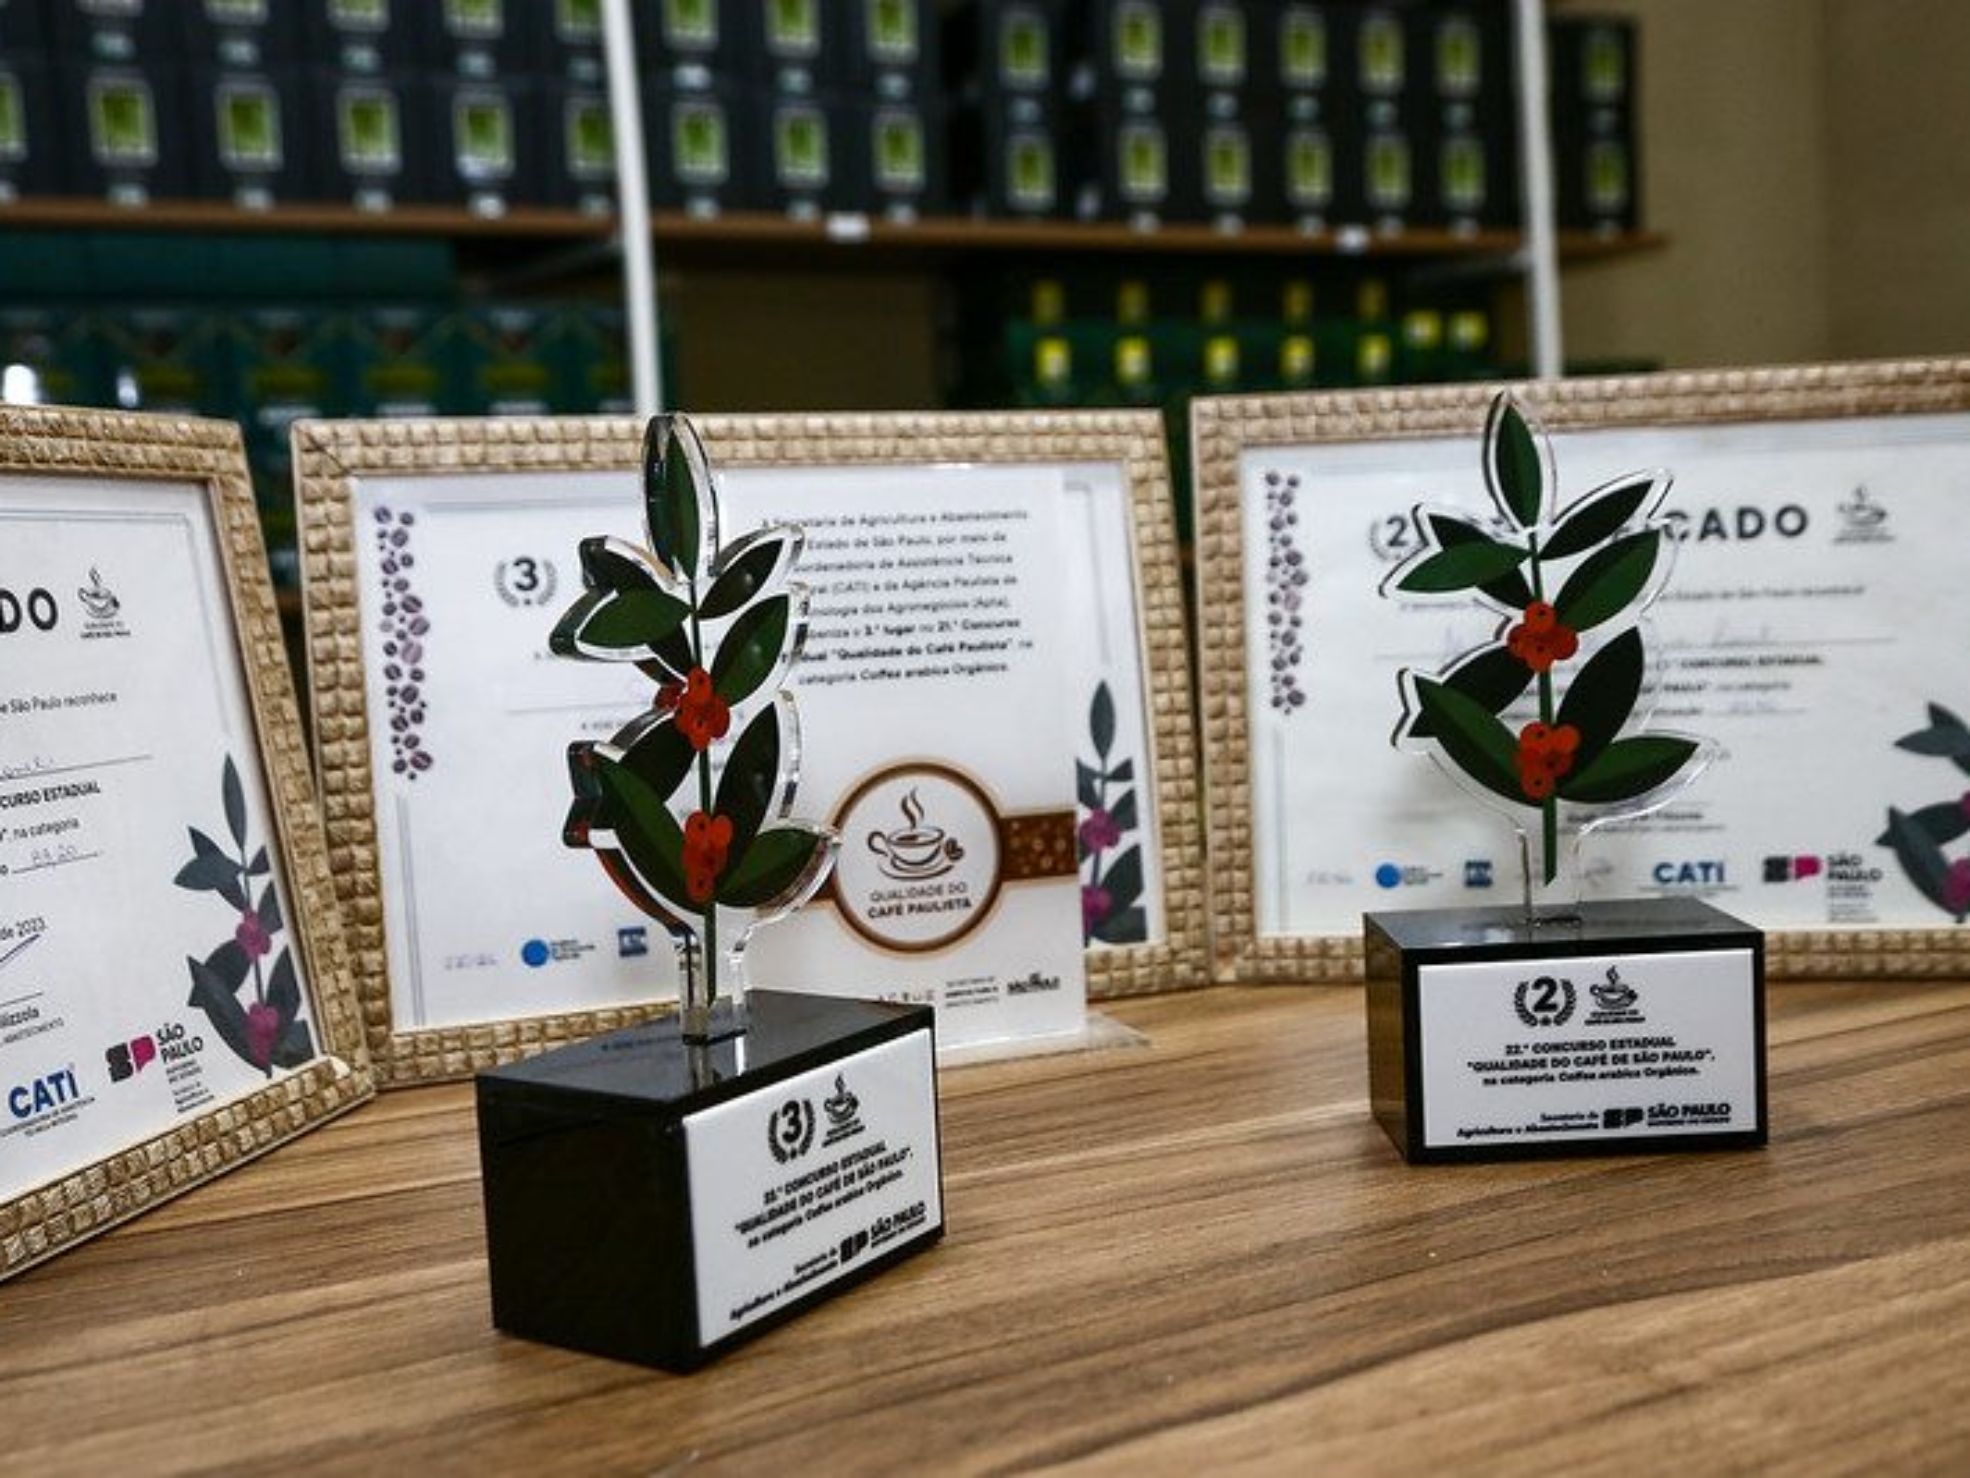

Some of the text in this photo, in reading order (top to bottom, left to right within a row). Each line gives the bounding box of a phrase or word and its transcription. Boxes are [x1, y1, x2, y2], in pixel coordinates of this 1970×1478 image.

[1387, 515, 1408, 548] 2
[513, 556, 539, 592] 3
[0, 788, 41, 809] CURSO
[1653, 861, 1725, 885] CATI
[1531, 975, 1559, 1013] 2
[1551, 1056, 1571, 1068] DO
[1611, 1052, 1629, 1066] DE
[1632, 1049, 1660, 1063] SÃO
[9, 1066, 79, 1119] CATI
[781, 1100, 802, 1144] 3
[1647, 1102, 1732, 1119] SÃO PAULO
